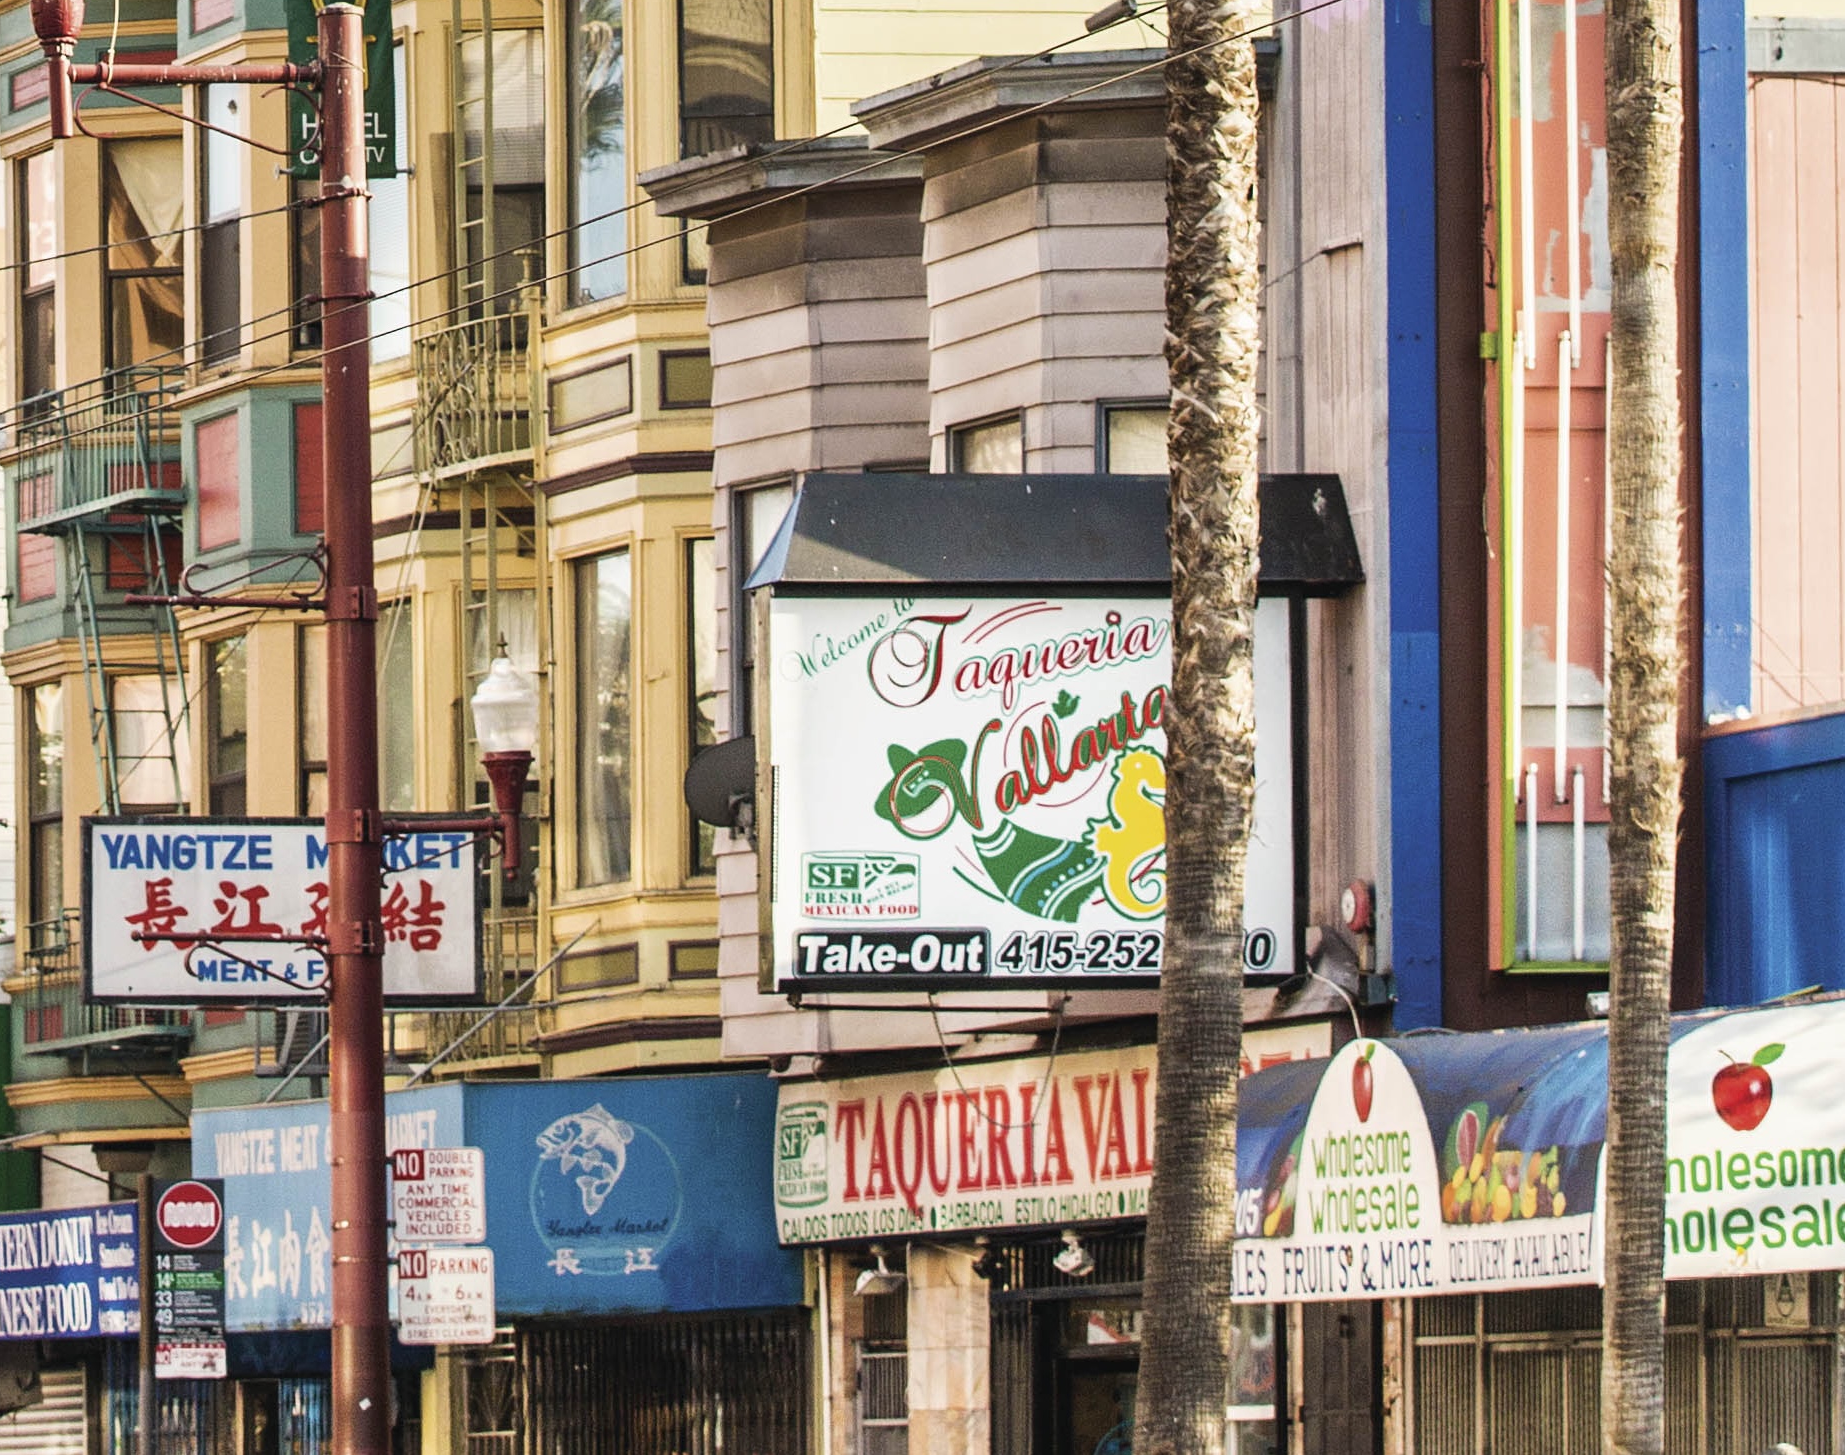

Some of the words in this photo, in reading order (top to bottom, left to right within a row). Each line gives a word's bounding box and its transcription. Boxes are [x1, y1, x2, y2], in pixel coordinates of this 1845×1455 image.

[782, 613, 889, 679] Welcome
[893, 597, 916, 618] to
[867, 603, 1170, 711] Taqueria
[101, 833, 273, 870] YANGTZE
[811, 864, 856, 887] SF
[805, 892, 863, 905] FRESH
[805, 904, 871, 915] MEXICAN
[879, 904, 919, 915] FOOD
[799, 933, 984, 973] Take-Out
[197, 959, 272, 983] MEAT
[283, 962, 298, 983] &
[214, 1128, 276, 1177] YANGTZE
[280, 1124, 319, 1172] MEAT
[834, 1076, 1075, 1218] TAQUERIA
[1311, 1129, 1411, 1179] wholesome
[395, 1152, 420, 1177] NO
[428, 1152, 474, 1164] DOUBLE
[428, 1167, 475, 1178] PARKING
[406, 1185, 435, 1195] ANY
[441, 1184, 469, 1195] TIME
[397, 1197, 478, 1209] COMMERCIAL
[1308, 1179, 1421, 1234] wholesale
[406, 1210, 471, 1222] VEHICLES
[782, 1214, 828, 1243] CALDOS
[831, 1211, 869, 1238] TODOS
[873, 1209, 895, 1233] LOS
[940, 1200, 1004, 1229] BARBACOA
[1015, 1197, 1056, 1224] ESTILO
[1059, 1191, 1113, 1221] HIDALGO
[39, 1215, 94, 1268] DONUT
[405, 1223, 472, 1235] INCLUDED
[156, 1254, 170, 1271] 14
[399, 1252, 426, 1277] NO
[429, 1258, 488, 1275] PARKING
[1282, 1245, 1350, 1296] FRUITS
[1360, 1244, 1376, 1291] &
[1448, 1238, 1507, 1283] DELIVERY
[45, 1281, 93, 1334] FOOD
[155, 1290, 173, 1308] 33
[155, 1308, 173, 1326] 49
[407, 1327, 439, 1339] STREET
